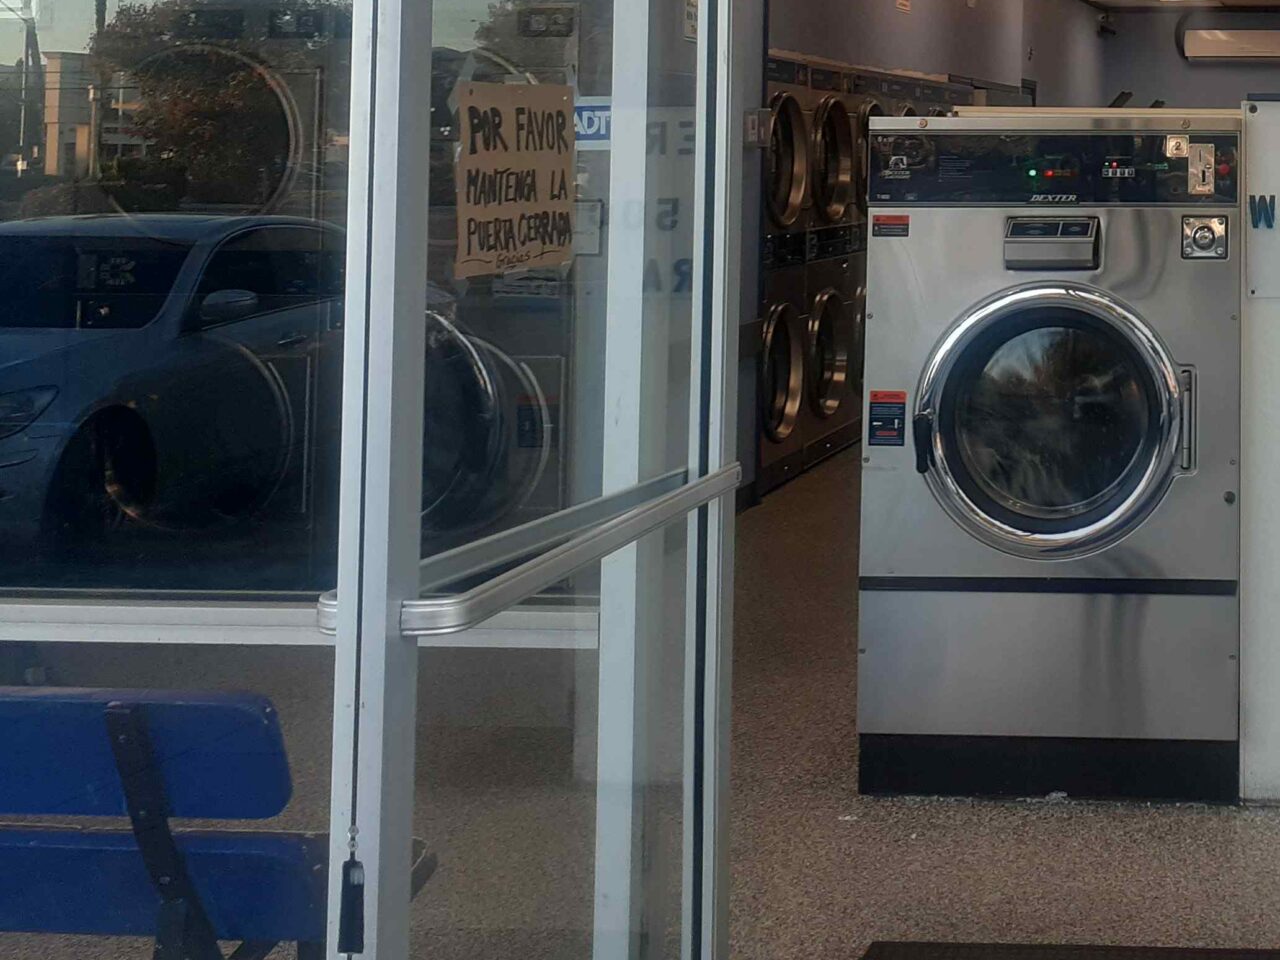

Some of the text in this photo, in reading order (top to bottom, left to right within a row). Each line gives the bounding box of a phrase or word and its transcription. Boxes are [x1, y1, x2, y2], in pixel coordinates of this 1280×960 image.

[467, 105, 569, 155] POR FAVOR
[1174, 141, 1182, 151] 2
[466, 167, 568, 207] MANTENGA LA
[1029, 194, 1078, 202] DEXTER
[467, 217, 517, 256] PUERTA
